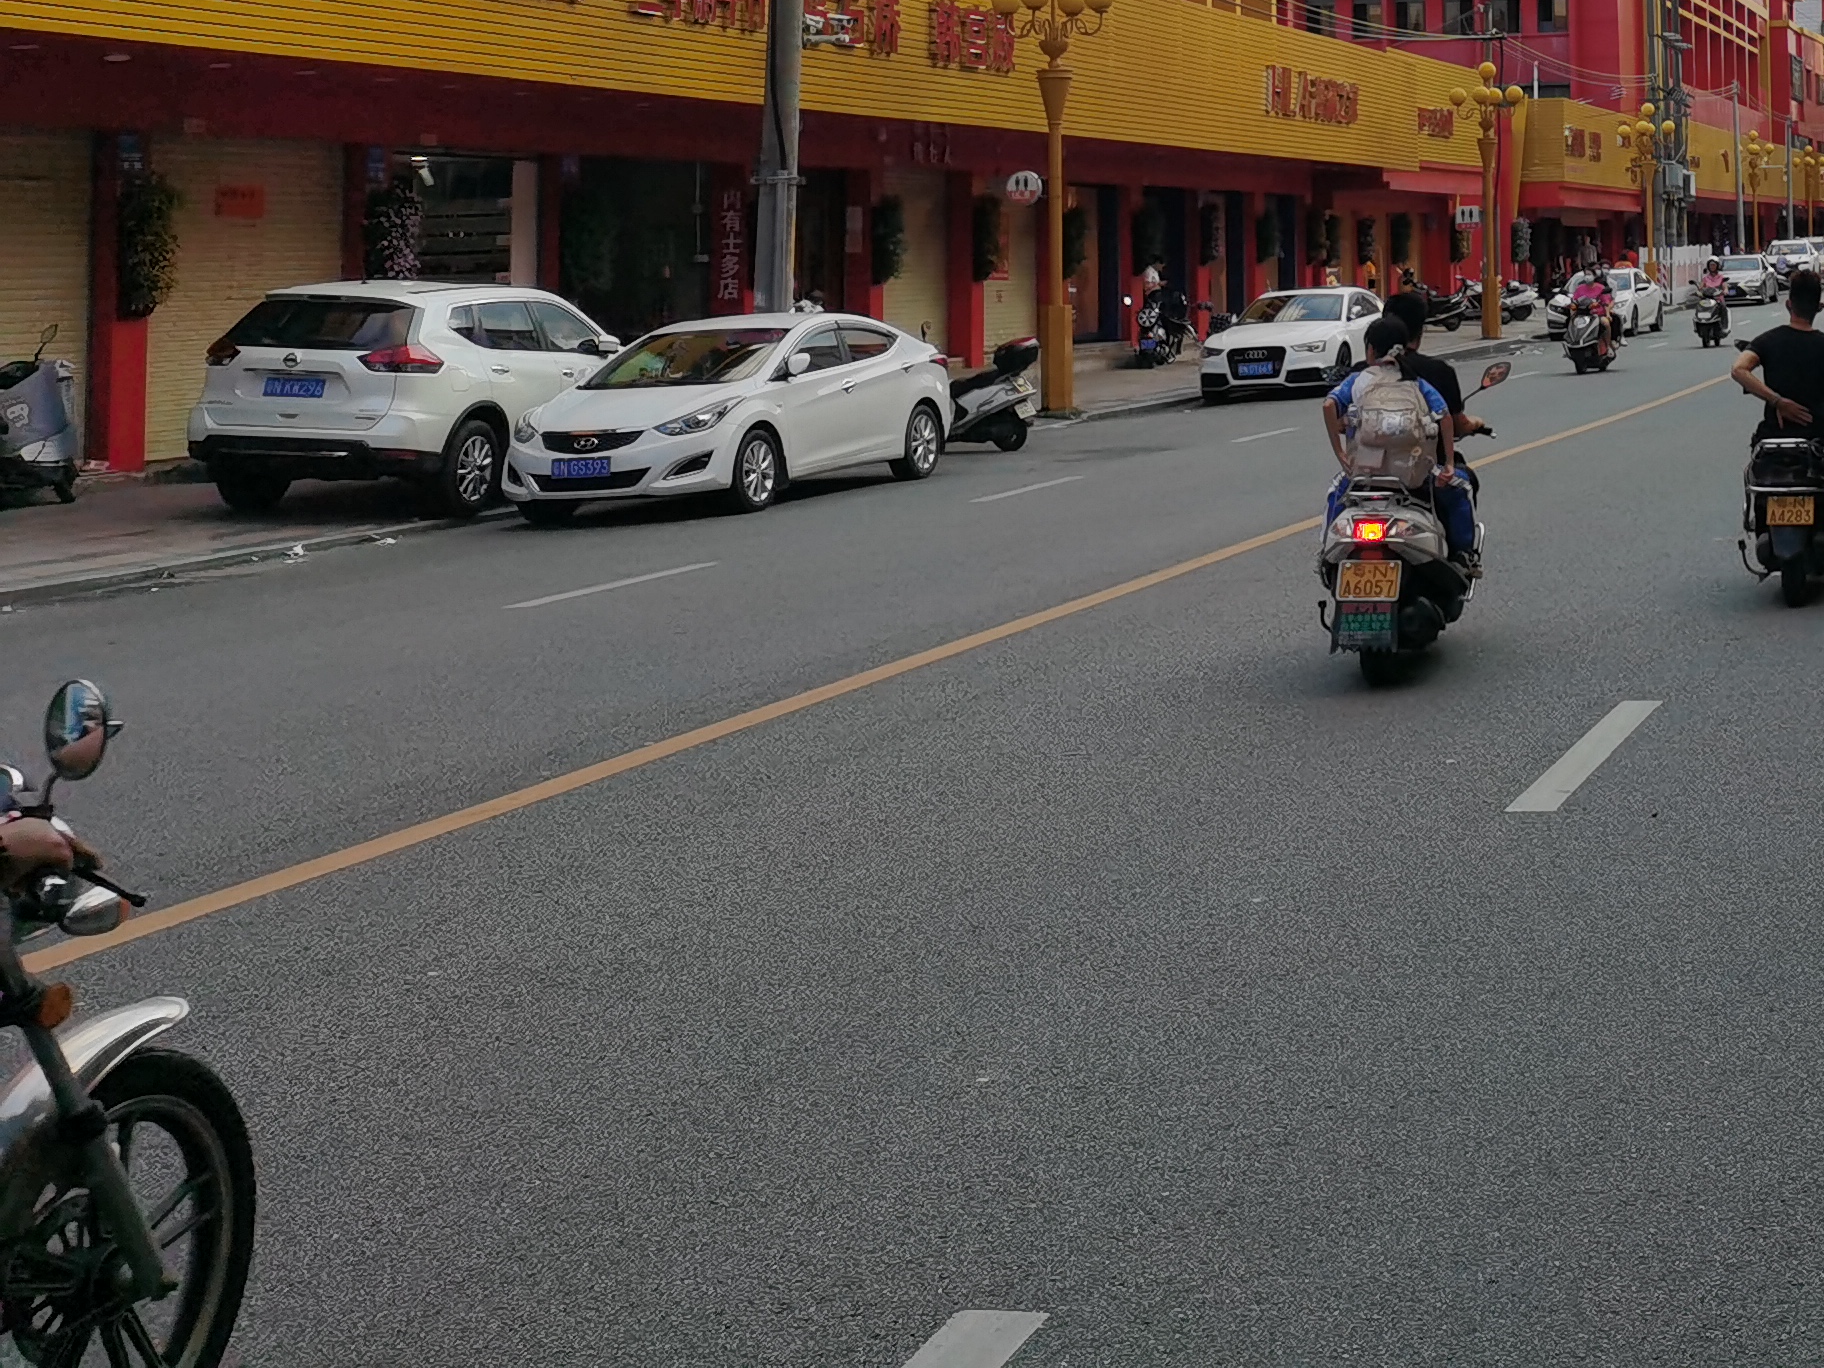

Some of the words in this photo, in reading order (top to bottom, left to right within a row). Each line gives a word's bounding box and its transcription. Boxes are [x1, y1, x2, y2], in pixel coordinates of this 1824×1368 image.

[717, 190, 743, 301] 内有士多店
[1770, 509, 1811, 523] A4283
[1342, 579, 1394, 597] A6057
